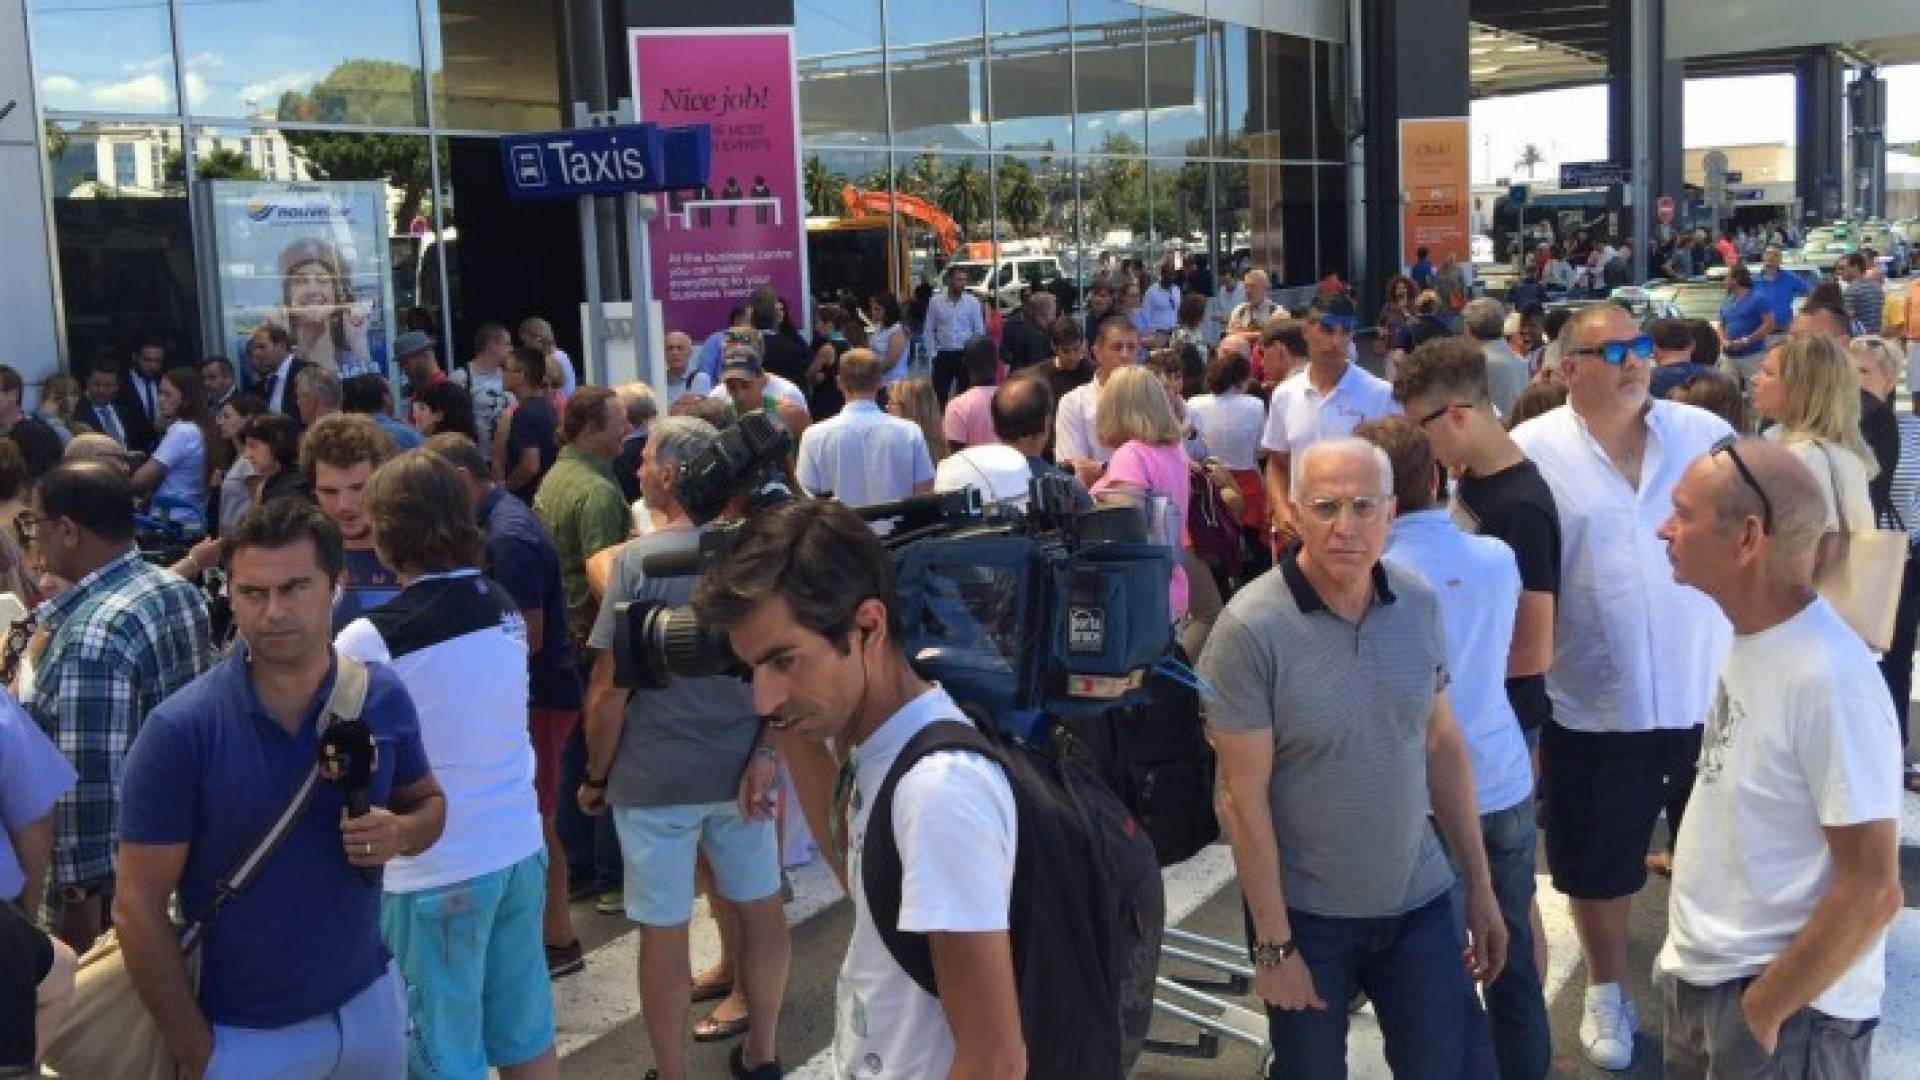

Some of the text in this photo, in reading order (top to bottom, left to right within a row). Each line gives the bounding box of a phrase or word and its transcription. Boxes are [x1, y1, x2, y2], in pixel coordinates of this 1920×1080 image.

[660, 84, 768, 116] Nice job!
[548, 136, 644, 184] Taxis
[704, 250, 753, 263] business
